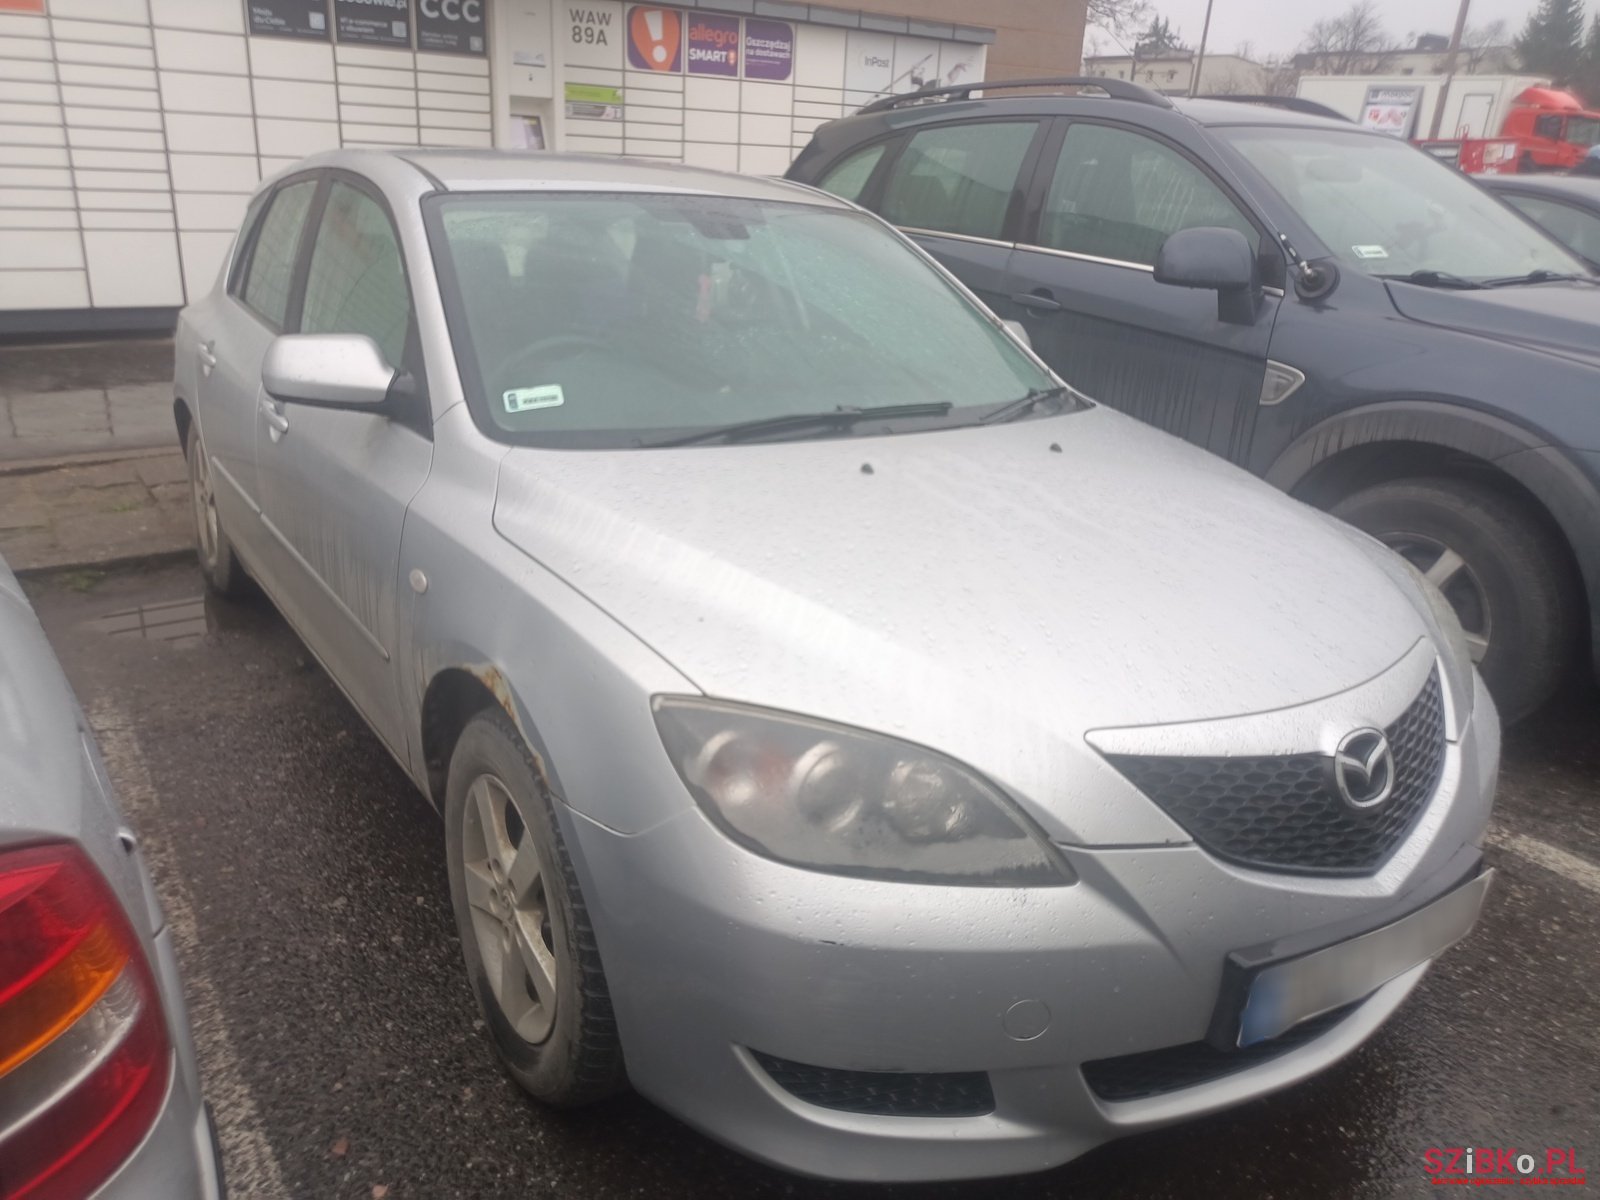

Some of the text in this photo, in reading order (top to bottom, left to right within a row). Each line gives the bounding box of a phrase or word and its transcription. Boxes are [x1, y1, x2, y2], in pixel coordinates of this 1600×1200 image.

[420, 0, 480, 23] CCC
[570, 8, 612, 27] WAW
[571, 26, 608, 46] 89A
[689, 23, 738, 48] allegro
[864, 55, 890, 68] InPost
